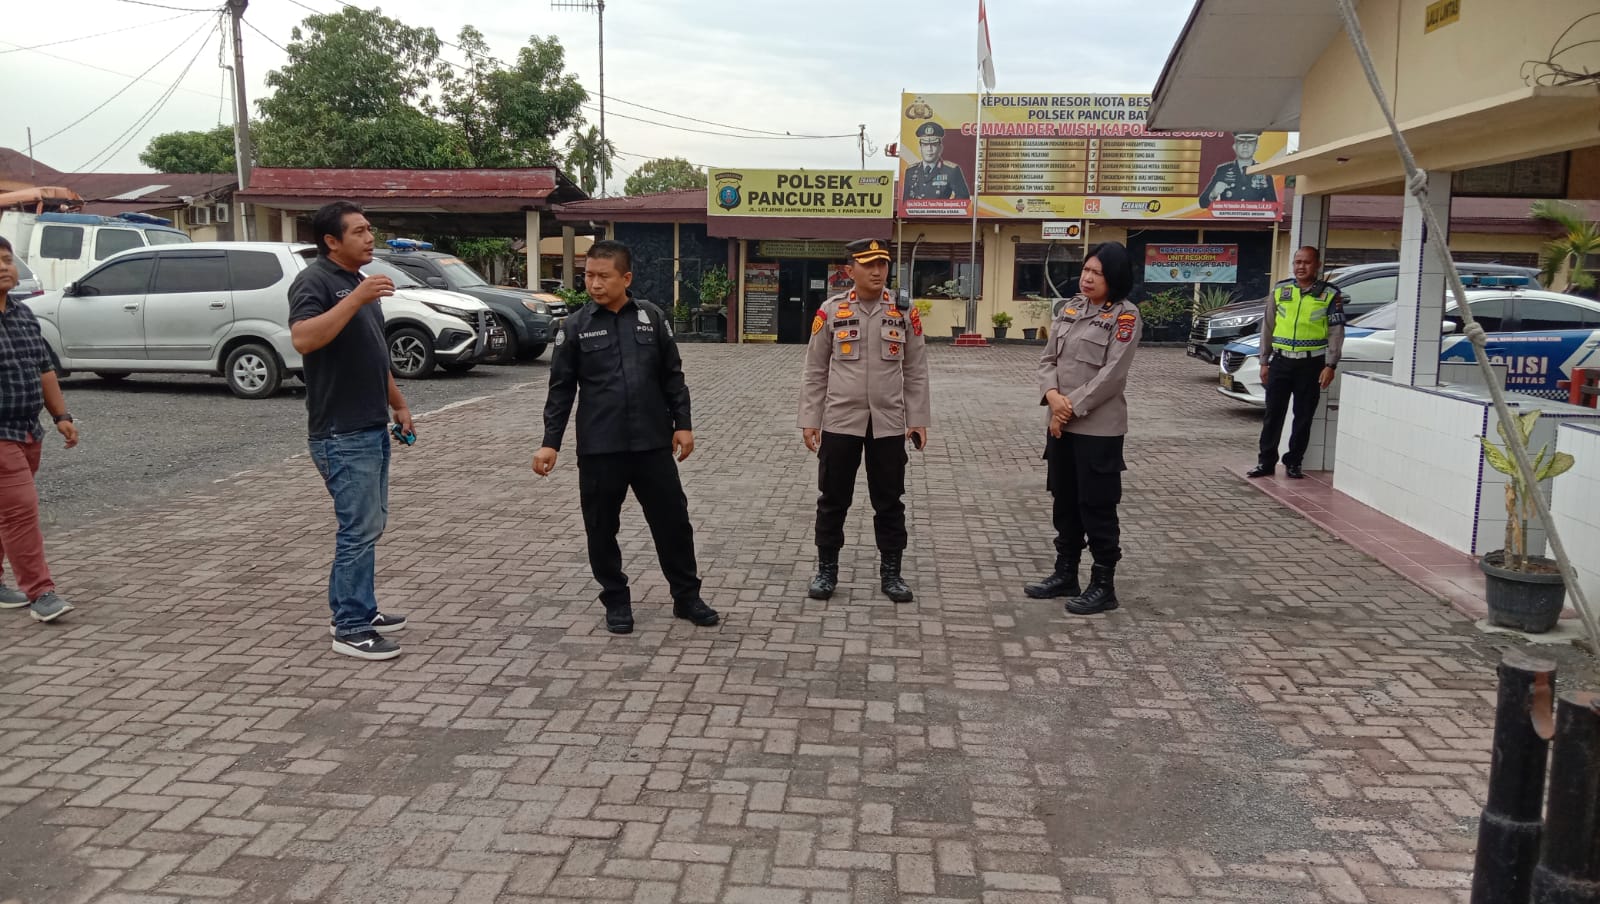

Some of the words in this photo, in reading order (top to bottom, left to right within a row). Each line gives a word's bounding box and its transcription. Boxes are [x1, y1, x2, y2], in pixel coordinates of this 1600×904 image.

[981, 96, 1049, 107] KEPOLISIAN
[1051, 96, 1092, 107] RESOR
[1095, 97, 1125, 107] KOTA
[1028, 109, 1074, 120] POLSEK
[1078, 110, 1125, 120] PANCUR
[961, 122, 1055, 136] COMMANDER
[1058, 123, 1097, 136] WISH
[777, 175, 853, 190] POLSEK
[748, 191, 826, 207] PANCUR
[832, 192, 882, 207] BATU
[1086, 201, 1099, 210] ck
[1089, 321, 1113, 331] POLRI
